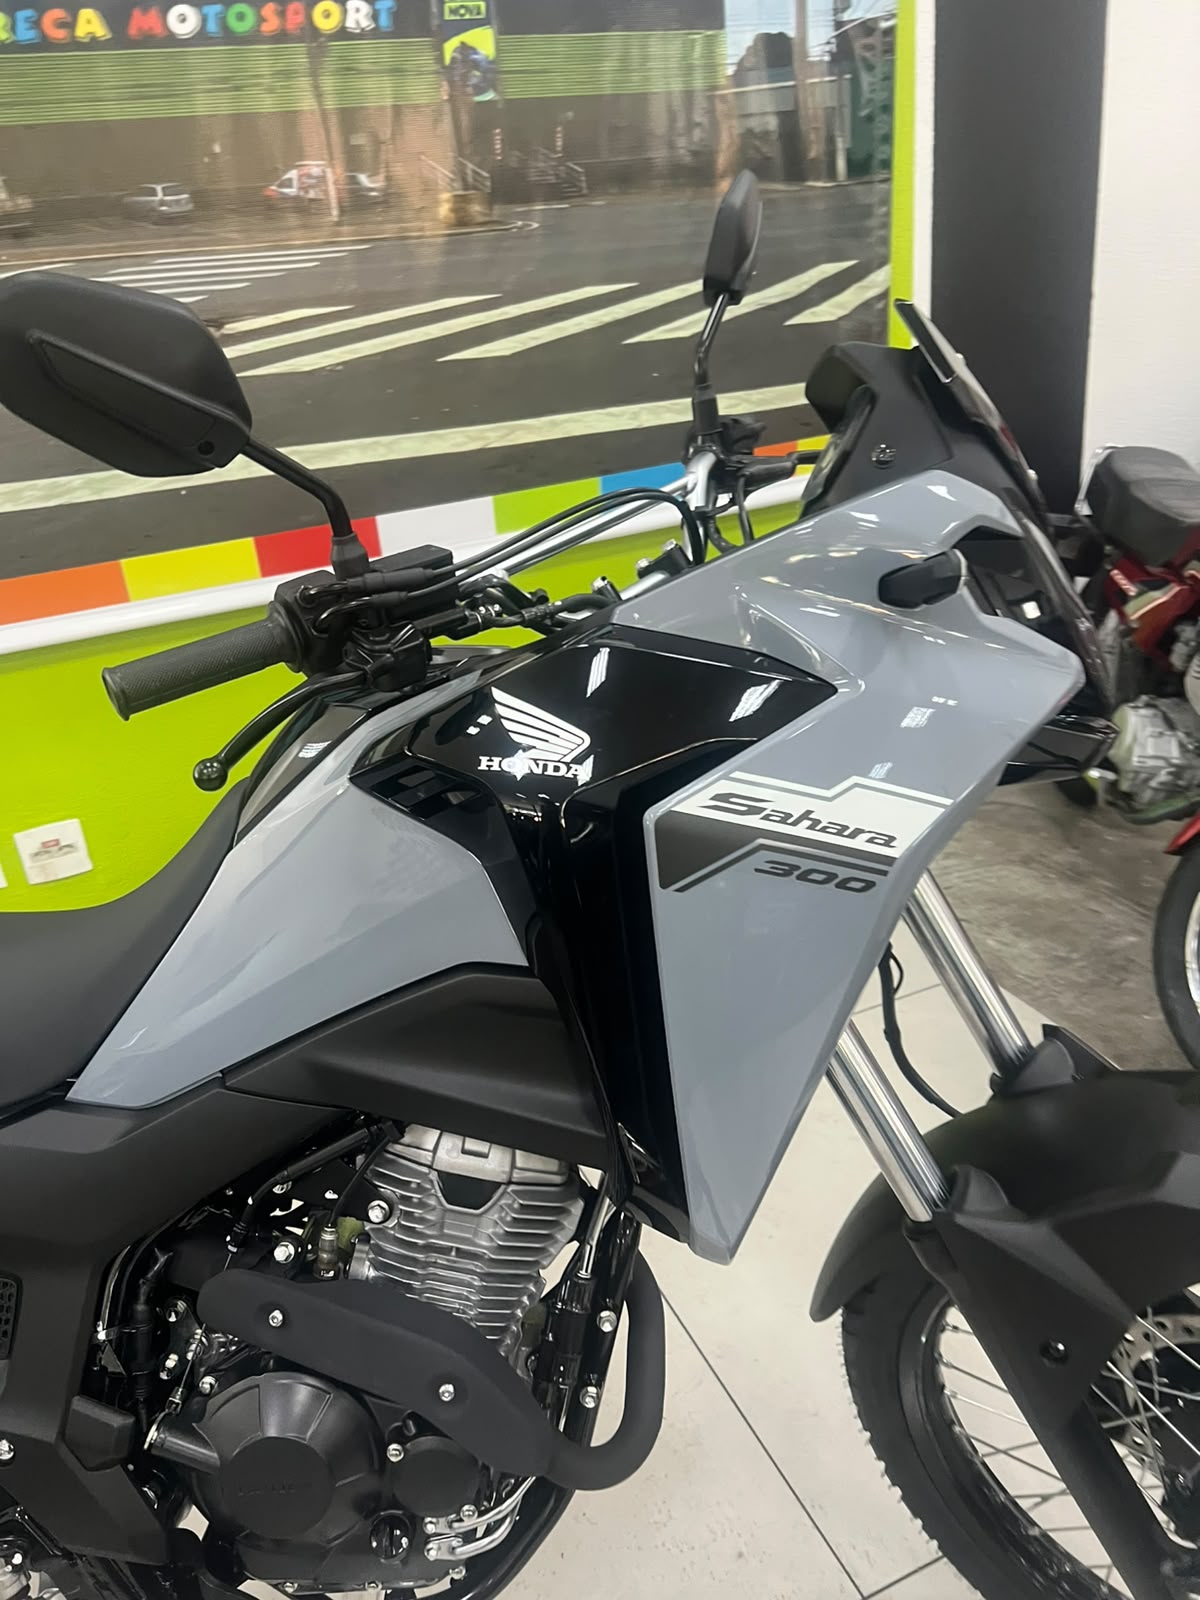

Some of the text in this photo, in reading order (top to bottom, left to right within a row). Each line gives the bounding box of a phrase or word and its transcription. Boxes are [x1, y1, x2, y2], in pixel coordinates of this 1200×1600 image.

[127, 0, 395, 39] MOTOSPORT
[477, 756, 587, 781] HONDA
[697, 792, 898, 848] Sahara
[754, 860, 877, 893] 300
